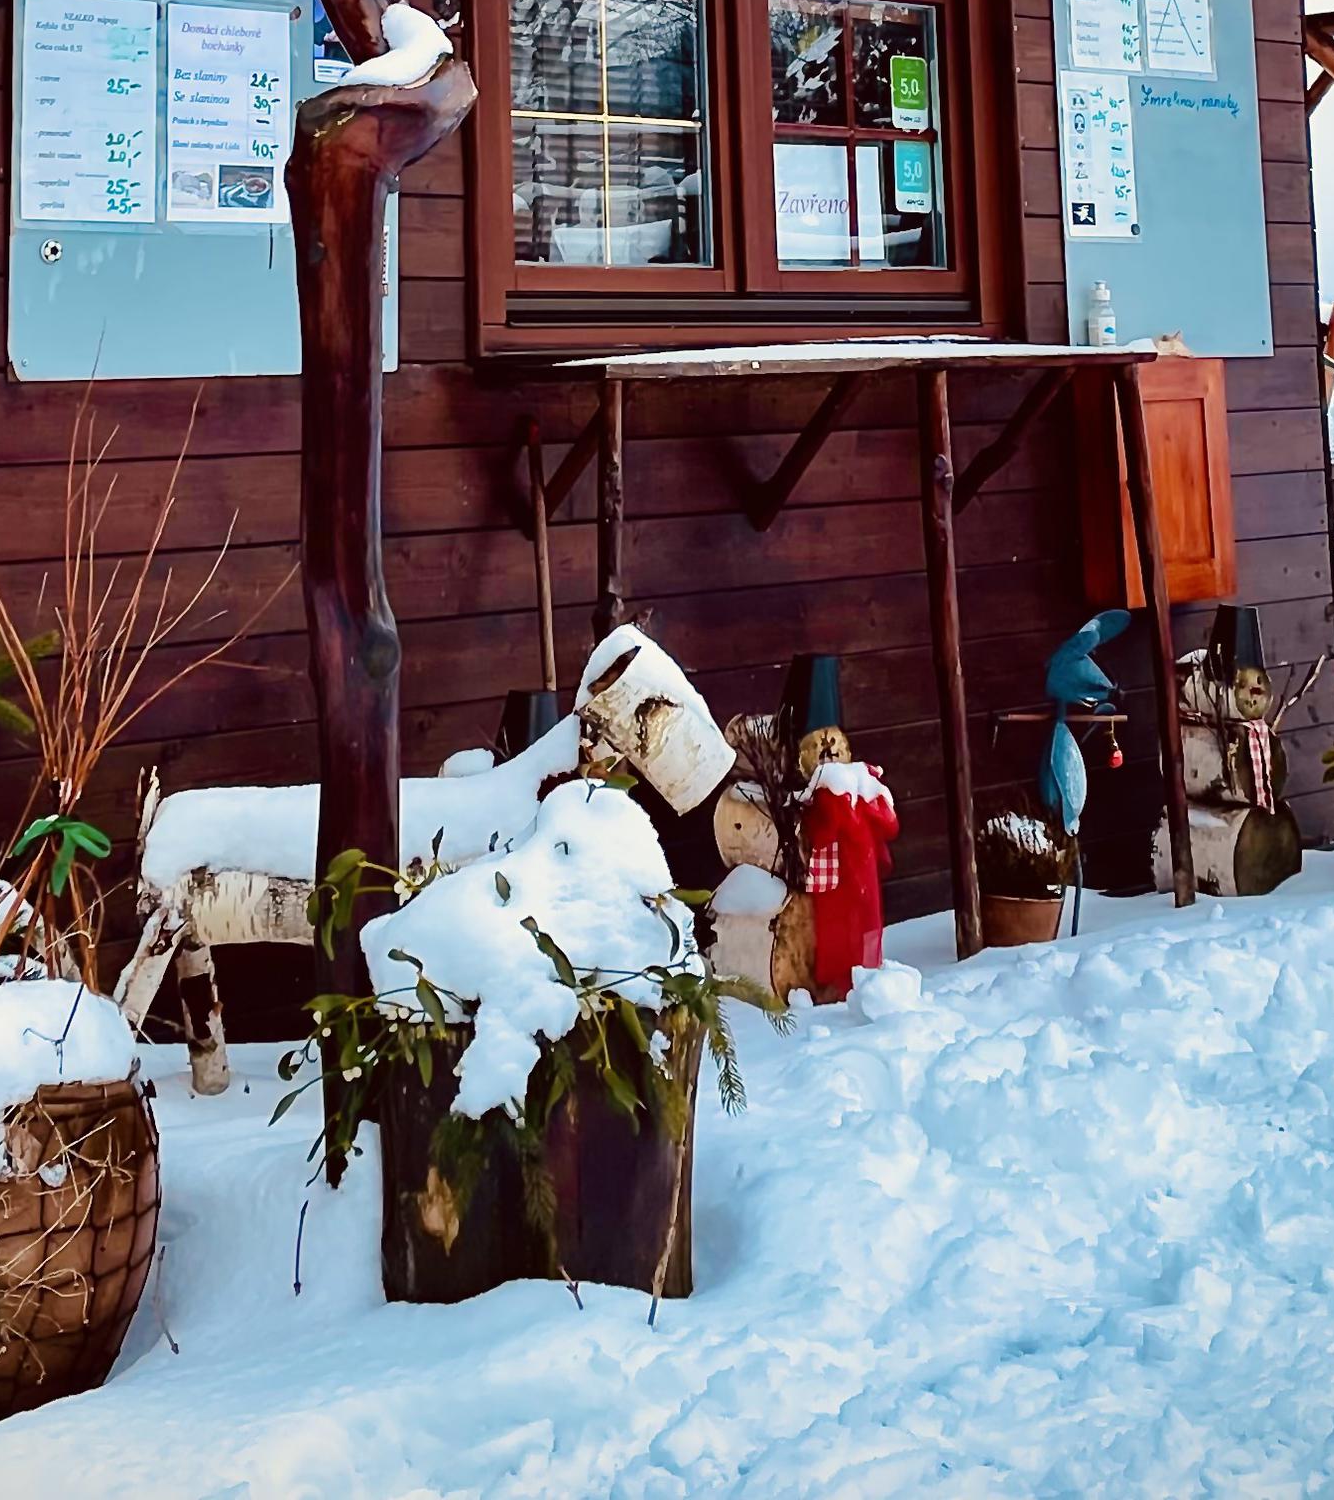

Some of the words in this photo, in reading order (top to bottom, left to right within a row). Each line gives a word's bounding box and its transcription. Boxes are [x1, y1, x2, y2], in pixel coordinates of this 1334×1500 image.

[174, 68, 191, 80] Bez
[193, 70, 228, 84] slaniny
[189, 92, 231, 104] slaninou
[900, 78, 919, 98] 5,0
[903, 160, 923, 181] 5,0
[777, 191, 849, 214] Zavřeno
